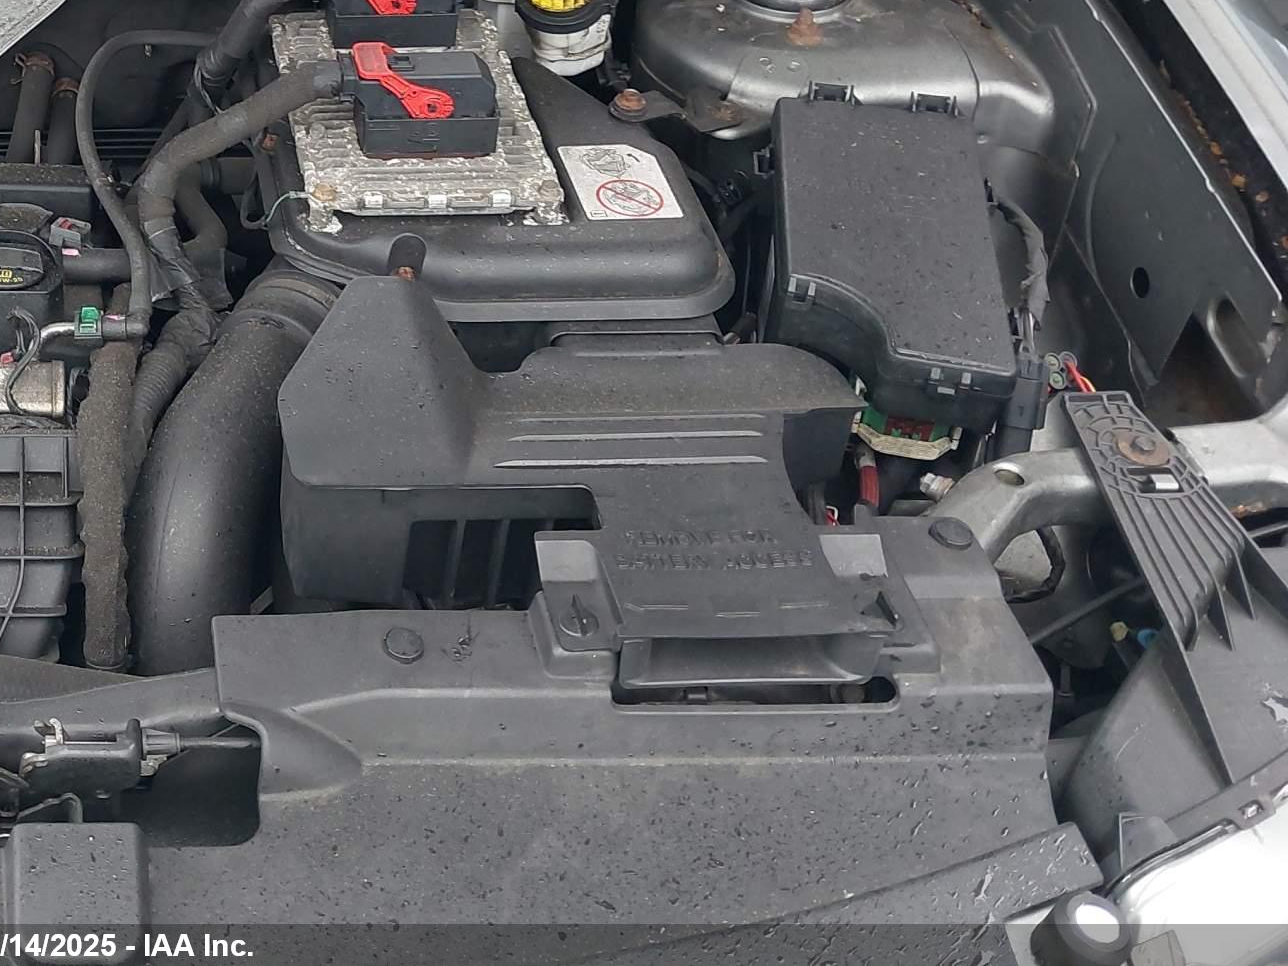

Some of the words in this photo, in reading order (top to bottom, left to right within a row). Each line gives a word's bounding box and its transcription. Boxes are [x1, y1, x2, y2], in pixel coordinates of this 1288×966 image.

[623, 529, 721, 547] REMOVE
[727, 529, 778, 547] FOR
[615, 552, 711, 570] BATTERY
[721, 548, 814, 570] ACCESS
